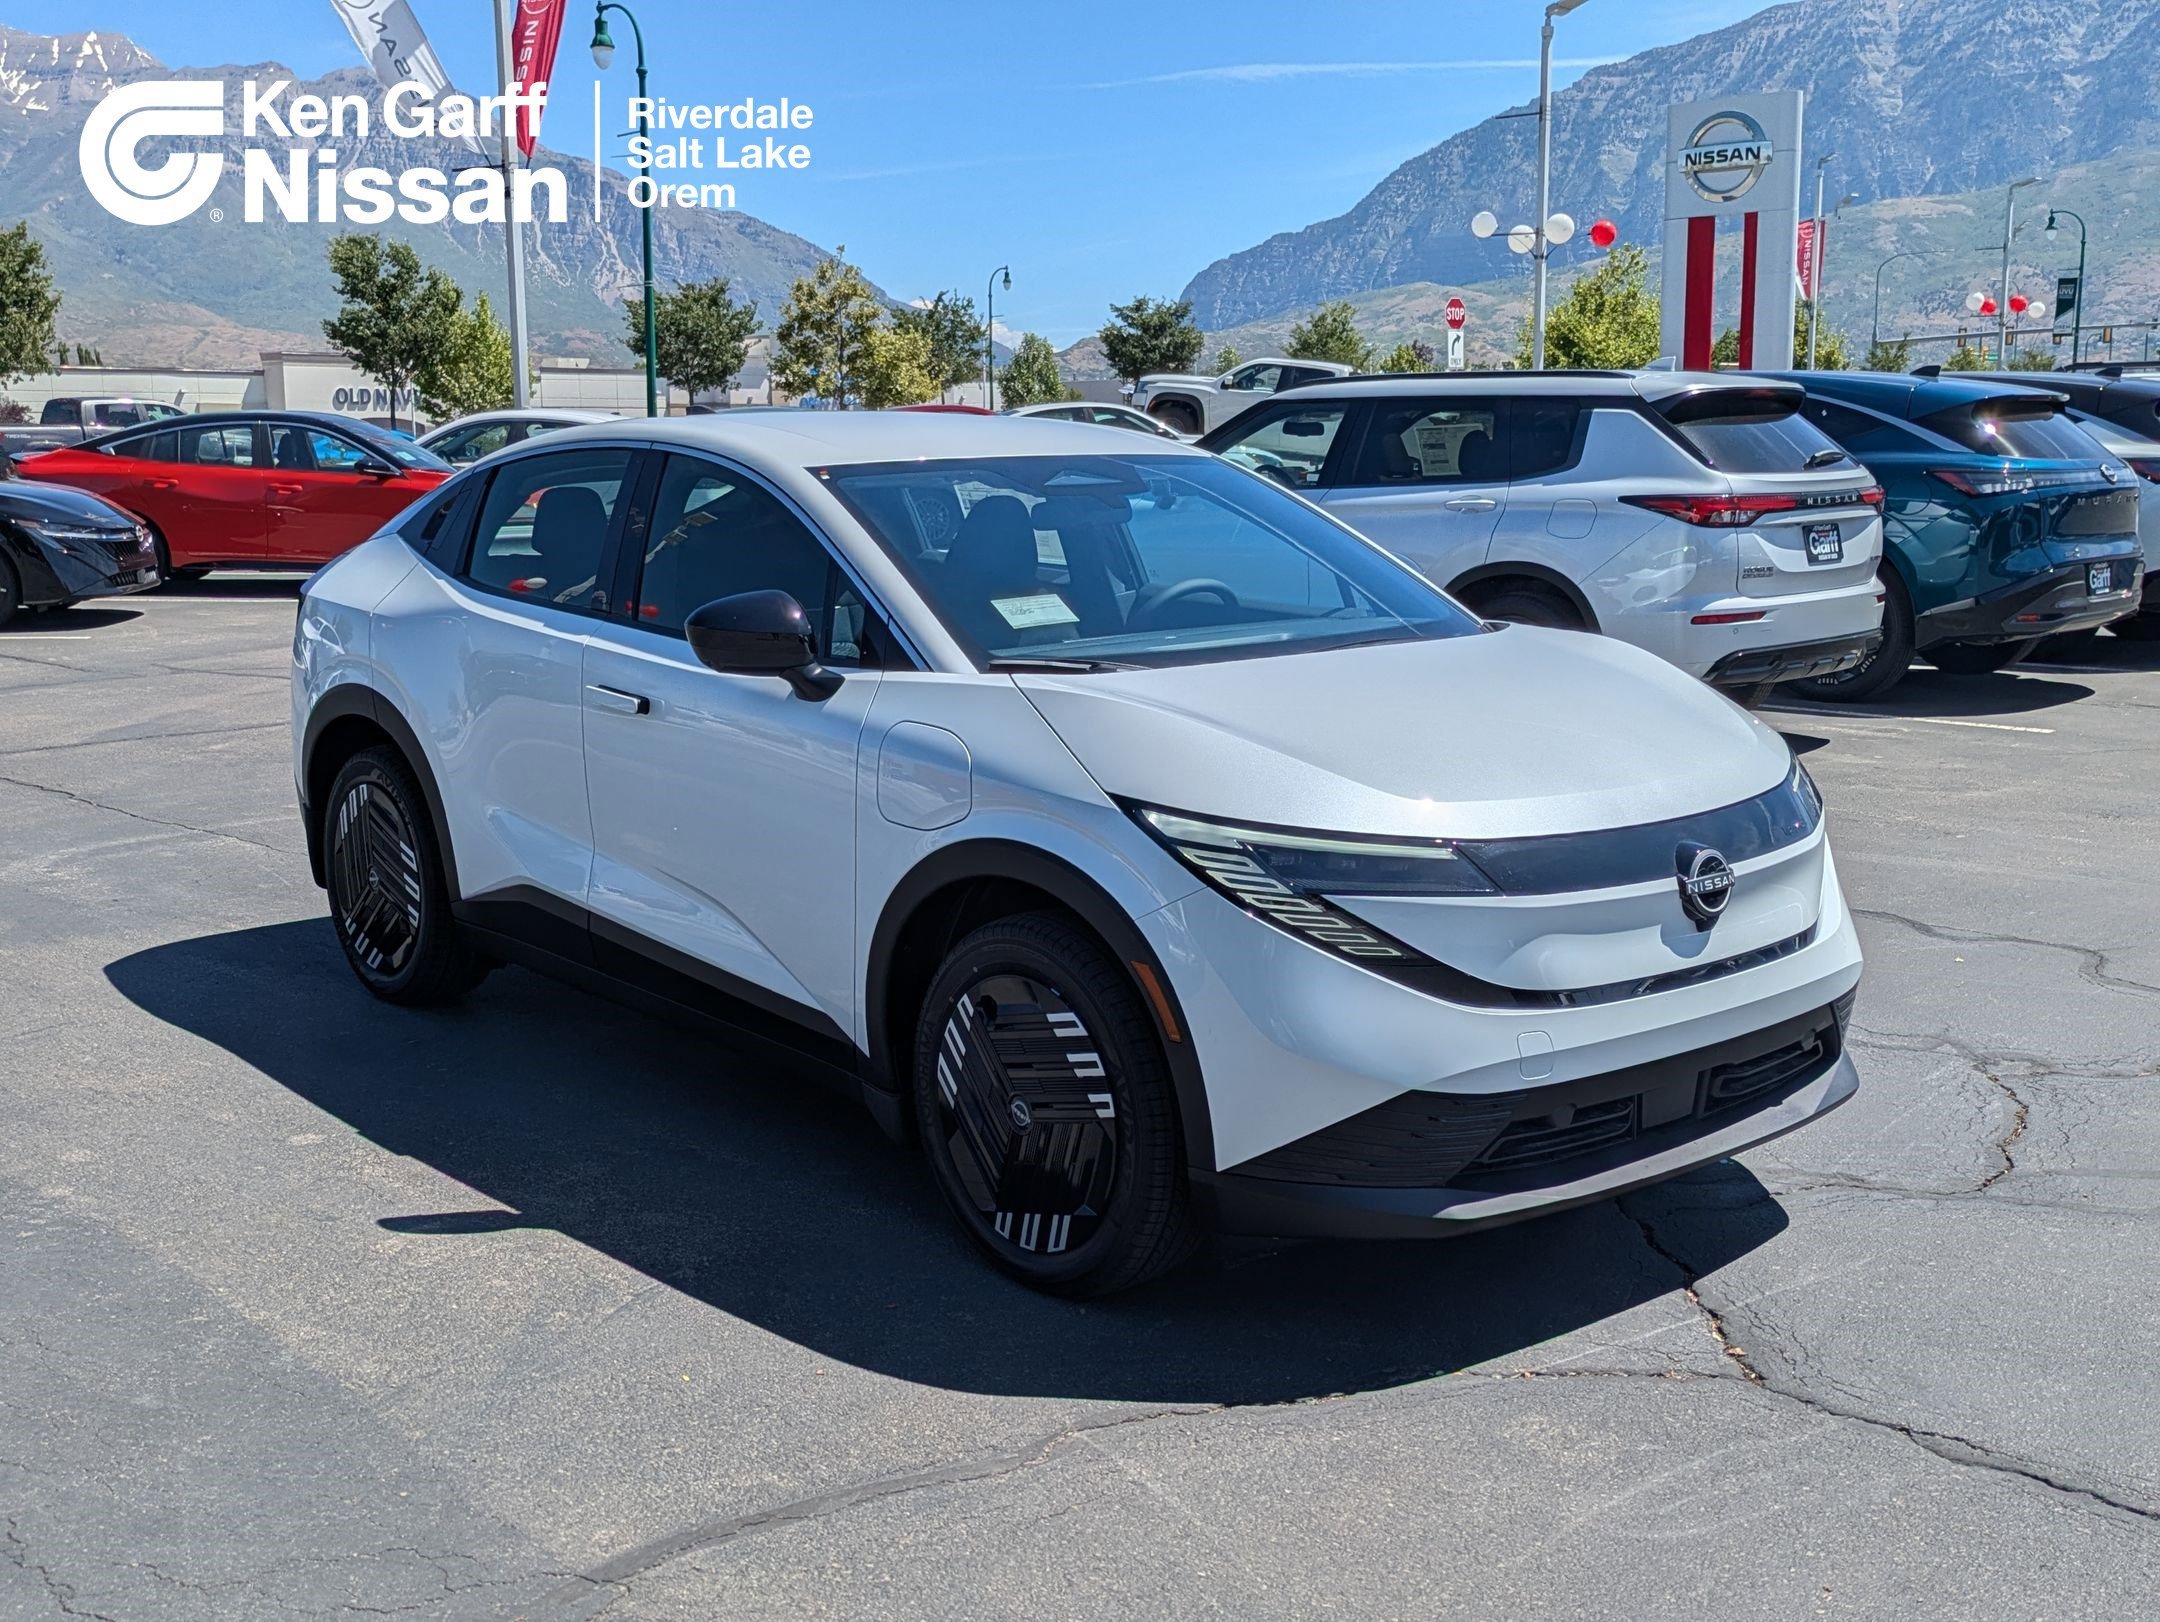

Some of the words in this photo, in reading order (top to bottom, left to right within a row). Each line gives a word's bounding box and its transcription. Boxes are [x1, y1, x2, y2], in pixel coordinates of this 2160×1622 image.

[1685, 145, 1761, 167] NISSAN
[1801, 240, 1812, 285] NISSAN
[1447, 308, 1464, 320] STOP
[334, 387, 371, 406] OLD
[1807, 494, 1858, 505] NISSAN
[1809, 530, 1839, 555] Garff
[2089, 567, 2112, 589] Garff
[1687, 874, 1735, 895] NISSAN
